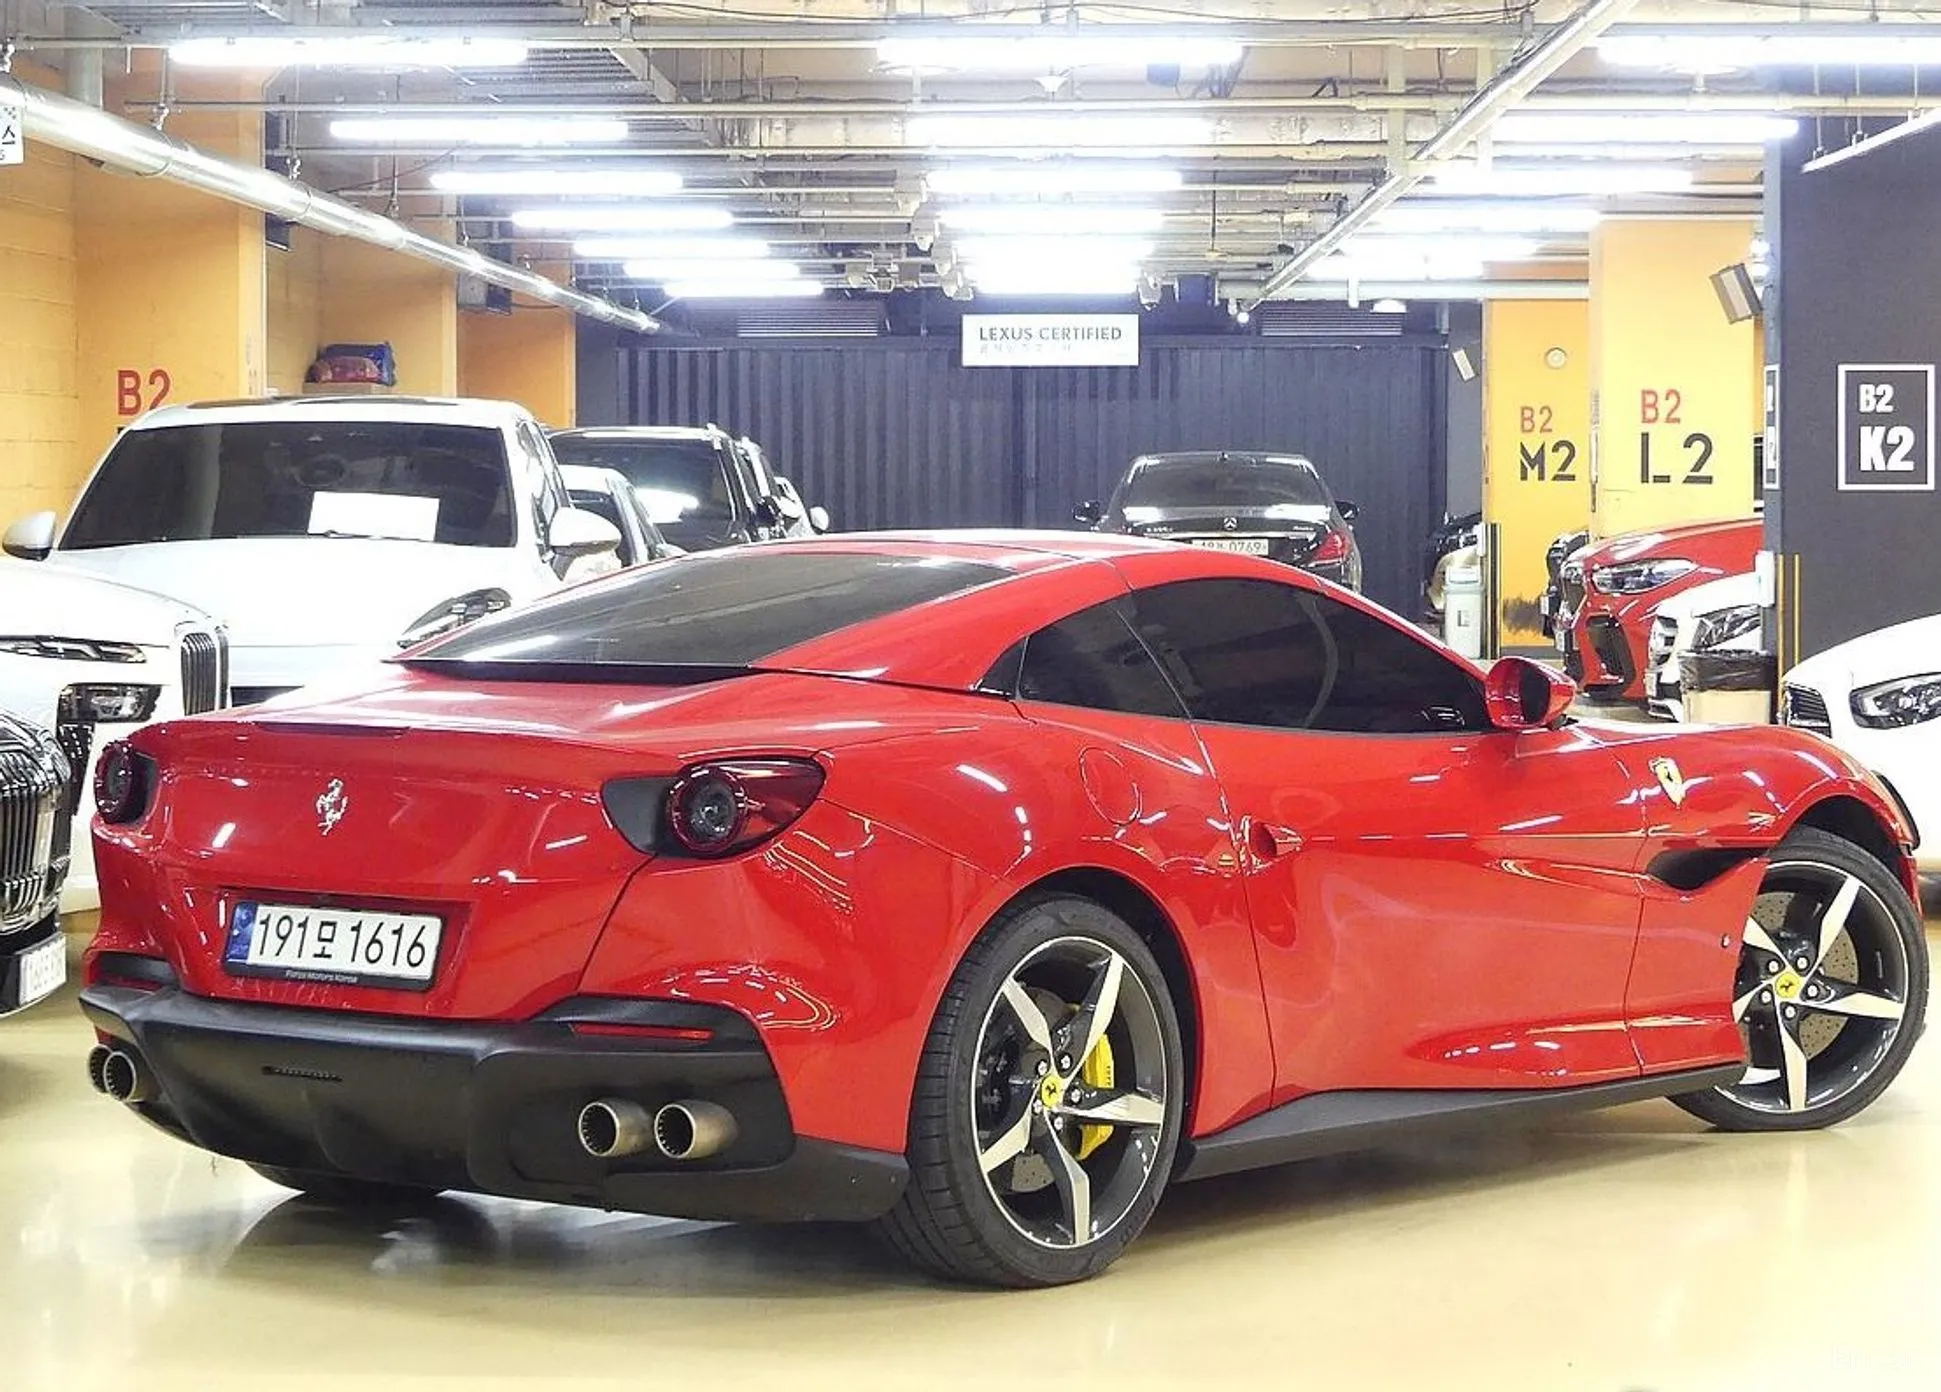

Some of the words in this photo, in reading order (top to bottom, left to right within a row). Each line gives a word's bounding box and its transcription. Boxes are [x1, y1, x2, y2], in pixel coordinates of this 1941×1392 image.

[979, 327, 1033, 341] LEXUS
[1039, 327, 1122, 341] CERTIFIED
[118, 370, 170, 415] B2
[1641, 389, 1681, 424] B2
[1859, 383, 1894, 413] B2
[1520, 406, 1553, 433] B2
[1520, 440, 1576, 481] M2
[1641, 432, 1713, 484] L2
[1860, 425, 1915, 471] K2
[350, 919, 426, 968] 1616
